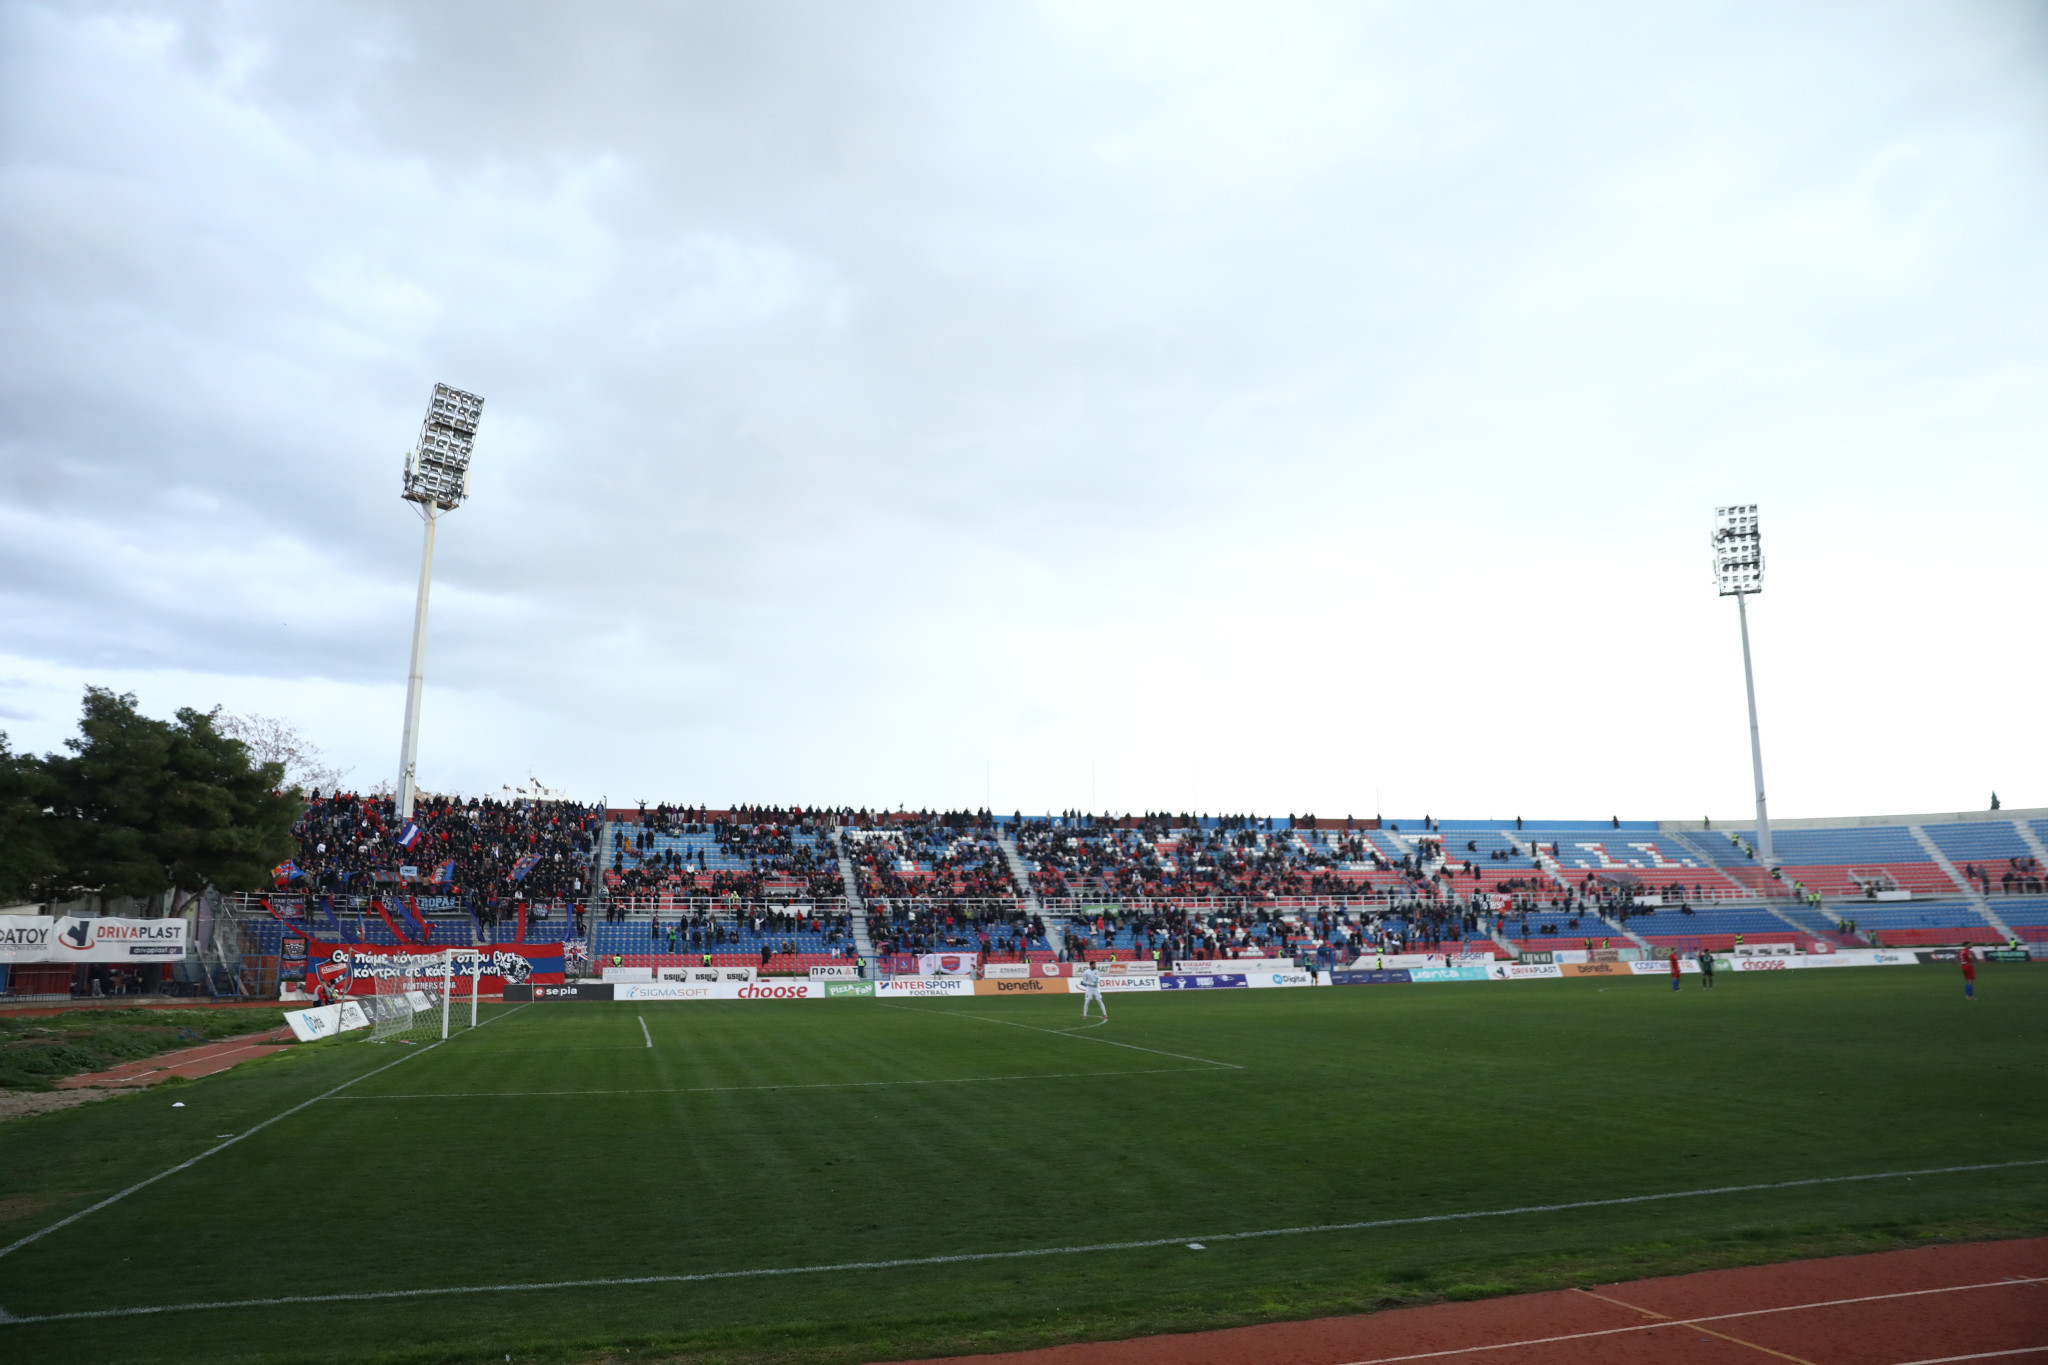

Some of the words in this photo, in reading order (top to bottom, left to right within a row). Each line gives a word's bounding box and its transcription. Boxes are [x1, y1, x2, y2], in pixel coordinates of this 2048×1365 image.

[97, 926, 181, 939] DRIVAPLAST
[891, 981, 961, 990] INTERSPORT
[997, 980, 1043, 991] benefit
[1099, 979, 1156, 987] DRIVAPLAST
[640, 988, 709, 997] SIGMASOFT
[737, 983, 808, 999] choose
